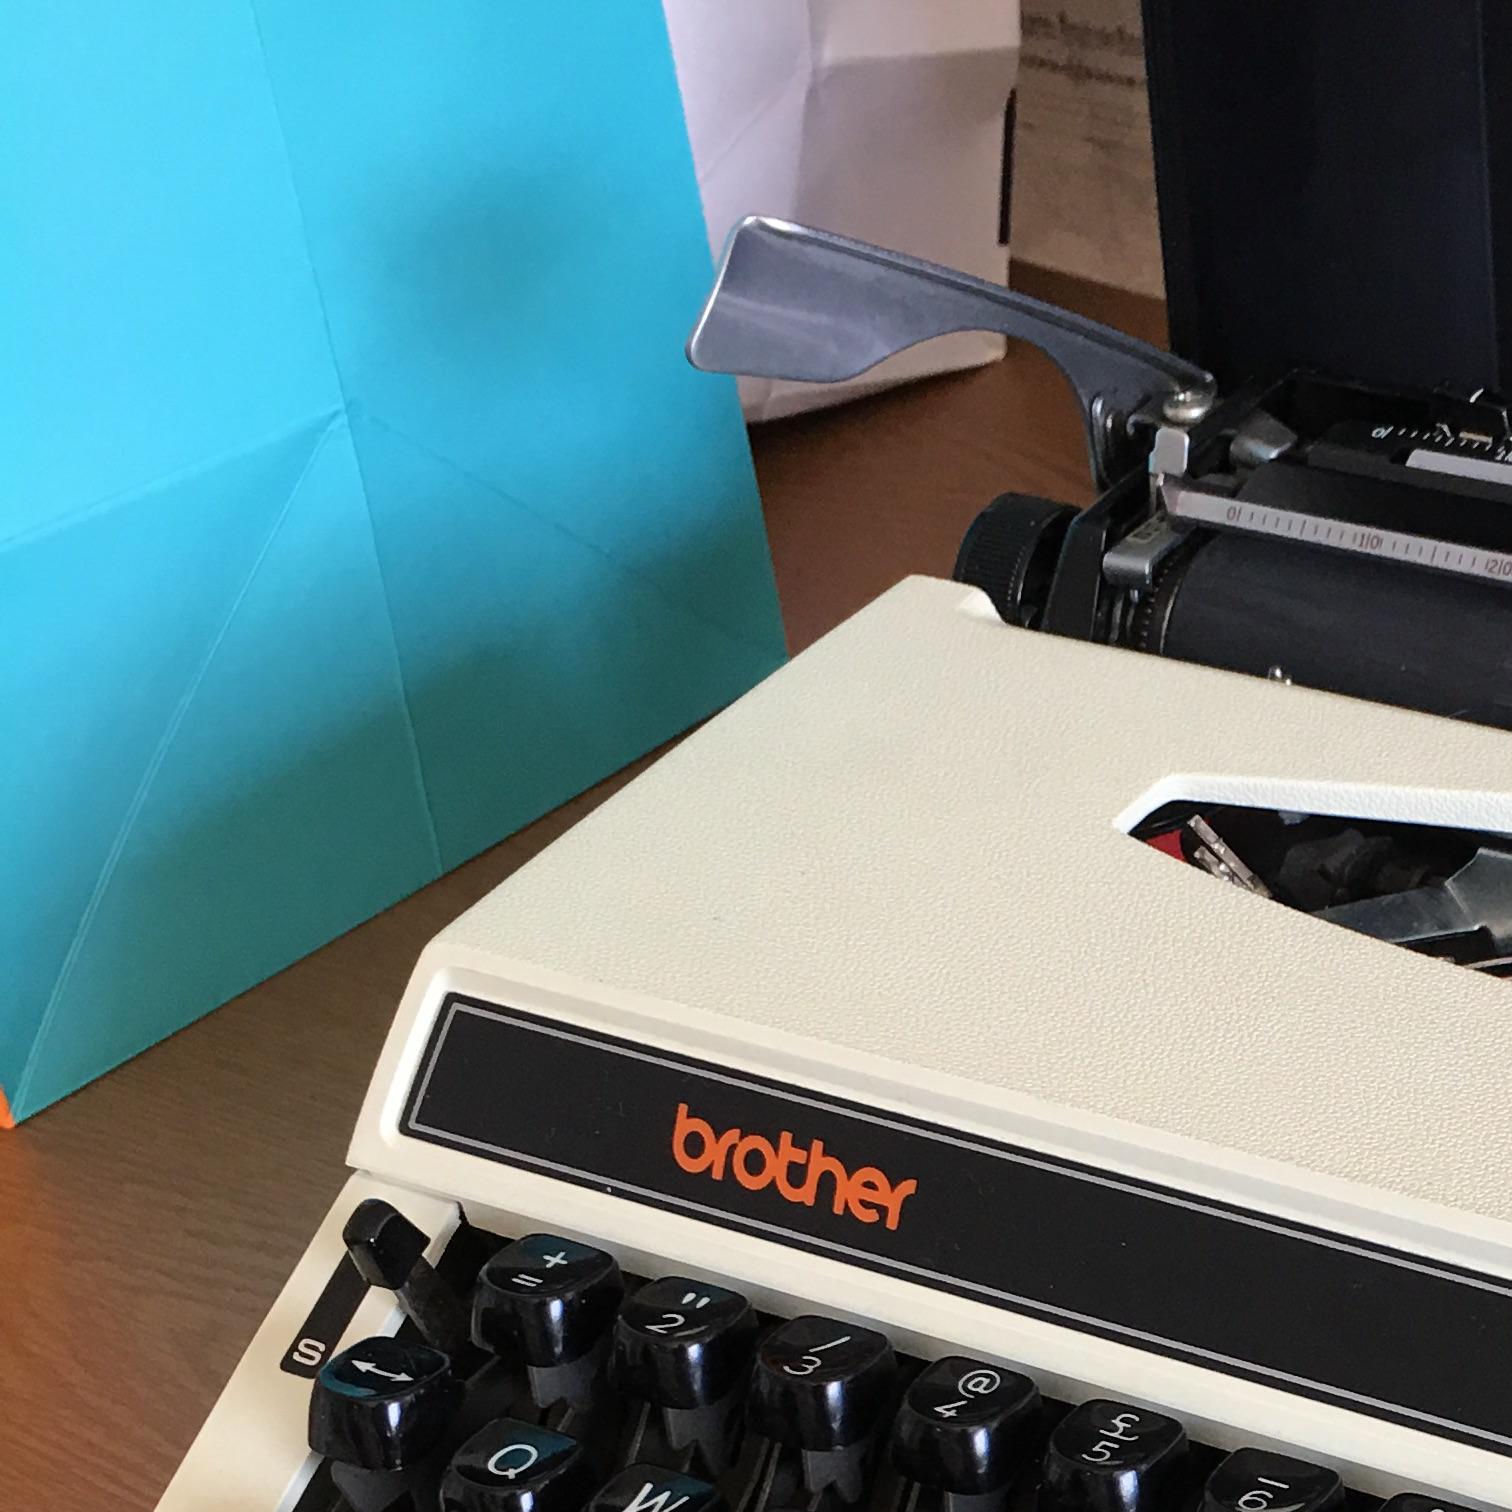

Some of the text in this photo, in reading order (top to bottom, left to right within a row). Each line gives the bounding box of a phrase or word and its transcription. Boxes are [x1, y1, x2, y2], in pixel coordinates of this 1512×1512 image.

[672, 1102, 917, 1231] brother
[646, 1314, 685, 1334] 2
[292, 1338, 326, 1366] S
[783, 1356, 822, 1375] 3
[958, 1369, 1001, 1399] @
[934, 1400, 968, 1418] 4
[487, 1443, 539, 1480] Q
[1081, 1441, 1120, 1463] 5
[1237, 1490, 1274, 1512] 6
